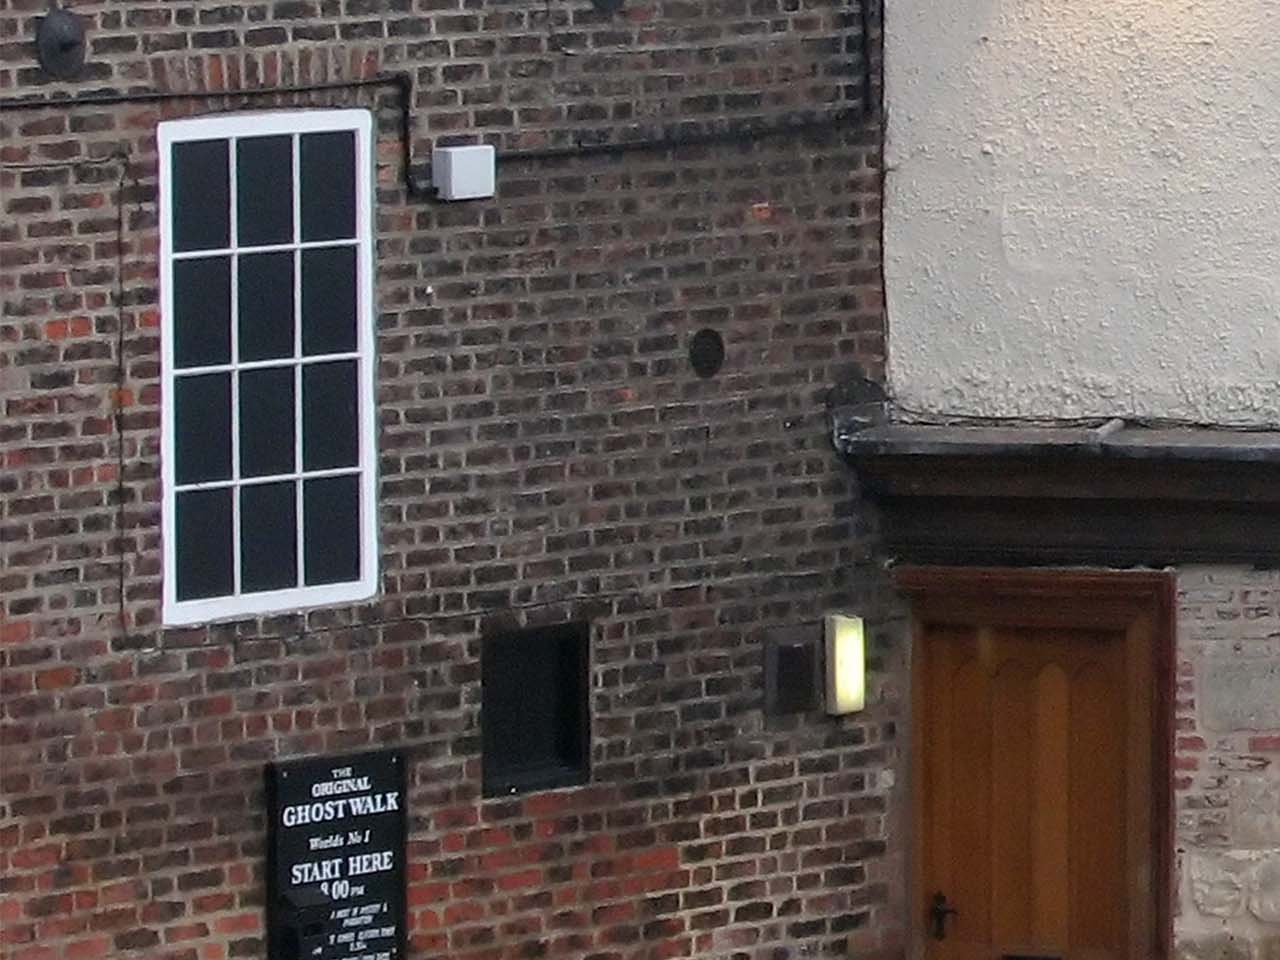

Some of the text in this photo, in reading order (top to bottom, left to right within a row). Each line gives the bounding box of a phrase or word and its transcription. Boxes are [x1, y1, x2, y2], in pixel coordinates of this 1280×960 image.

[312, 776, 372, 797] ORIGINAL
[331, 767, 353, 779] THE
[283, 792, 399, 827] GHOST WALK
[291, 851, 394, 884] START HERE
